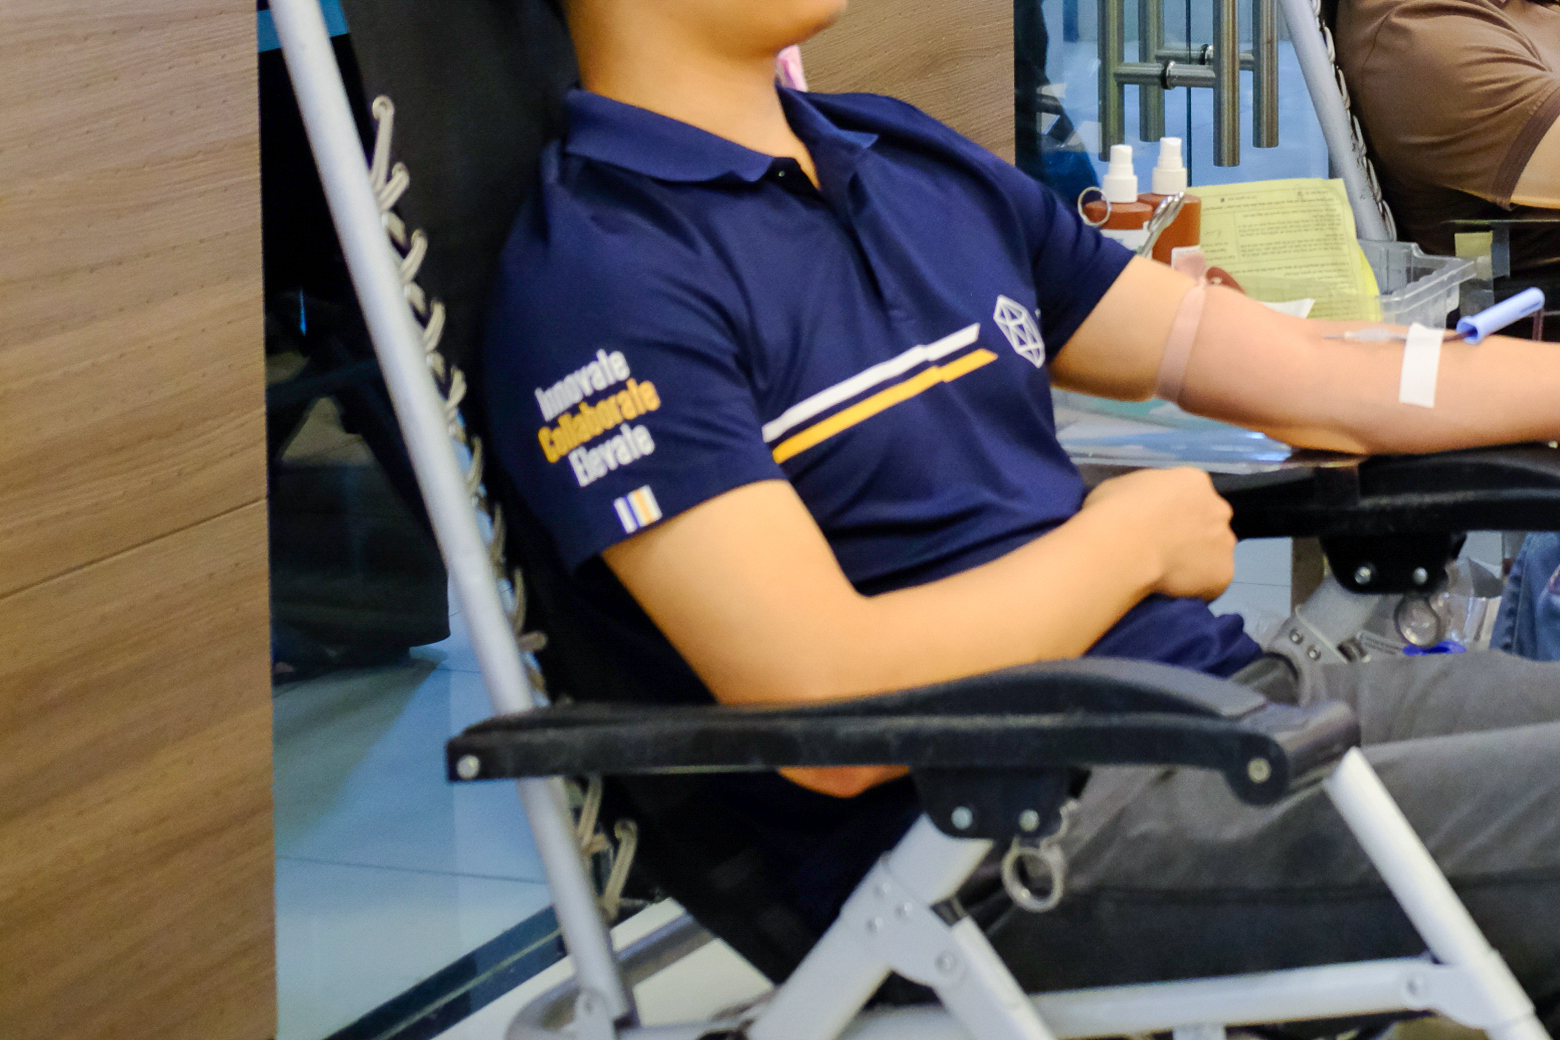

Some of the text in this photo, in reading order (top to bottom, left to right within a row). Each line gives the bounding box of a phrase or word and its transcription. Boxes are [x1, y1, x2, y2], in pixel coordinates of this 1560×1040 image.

[534, 348, 630, 422] Innovate
[538, 377, 661, 463] Collaborate
[568, 422, 655, 487] Elevate
